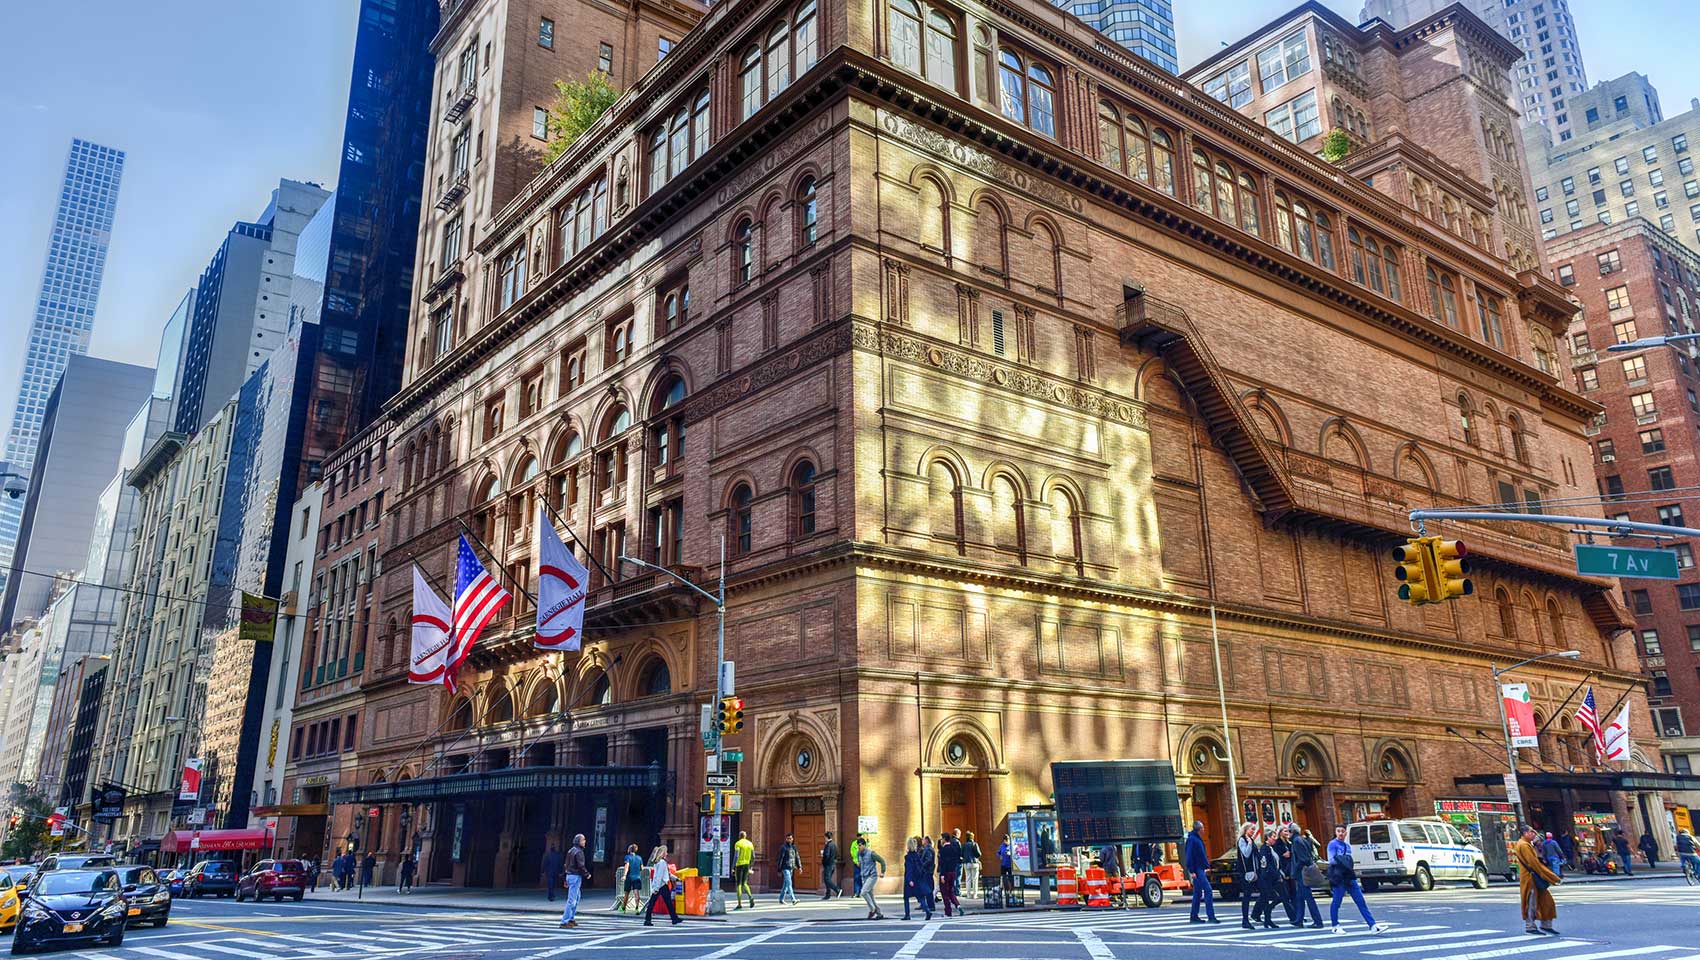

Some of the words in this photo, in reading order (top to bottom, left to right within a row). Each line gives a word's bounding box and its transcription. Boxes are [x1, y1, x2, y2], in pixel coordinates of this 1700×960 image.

[1608, 553, 1618, 570] 7
[1627, 554, 1648, 571] Av
[539, 600, 567, 624] CARNEGIE
[566, 590, 584, 604] HALL
[412, 643, 440, 663] CARNEGIE
[1453, 853, 1470, 863] NYPD
